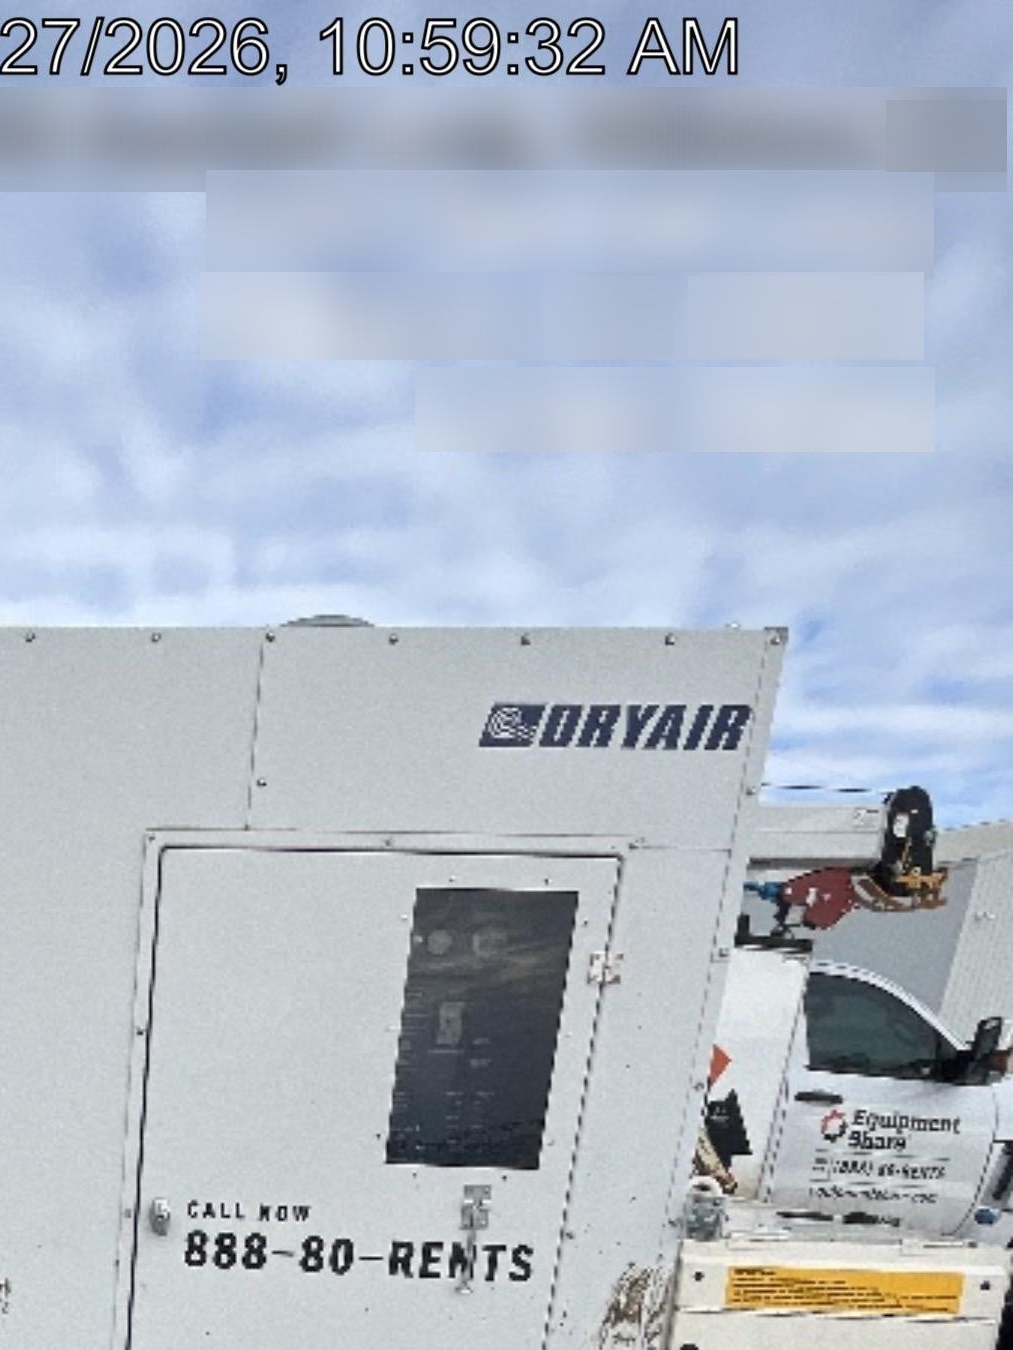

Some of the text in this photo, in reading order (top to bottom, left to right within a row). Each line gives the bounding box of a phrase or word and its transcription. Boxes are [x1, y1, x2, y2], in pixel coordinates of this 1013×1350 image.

[539, 703, 754, 750] DRYAIR
[852, 1109, 961, 1135] Equipment
[848, 1131, 907, 1151] Share
[187, 1200, 312, 1222] CALL NOW
[184, 1229, 535, 1282] 888-80-RENTS
